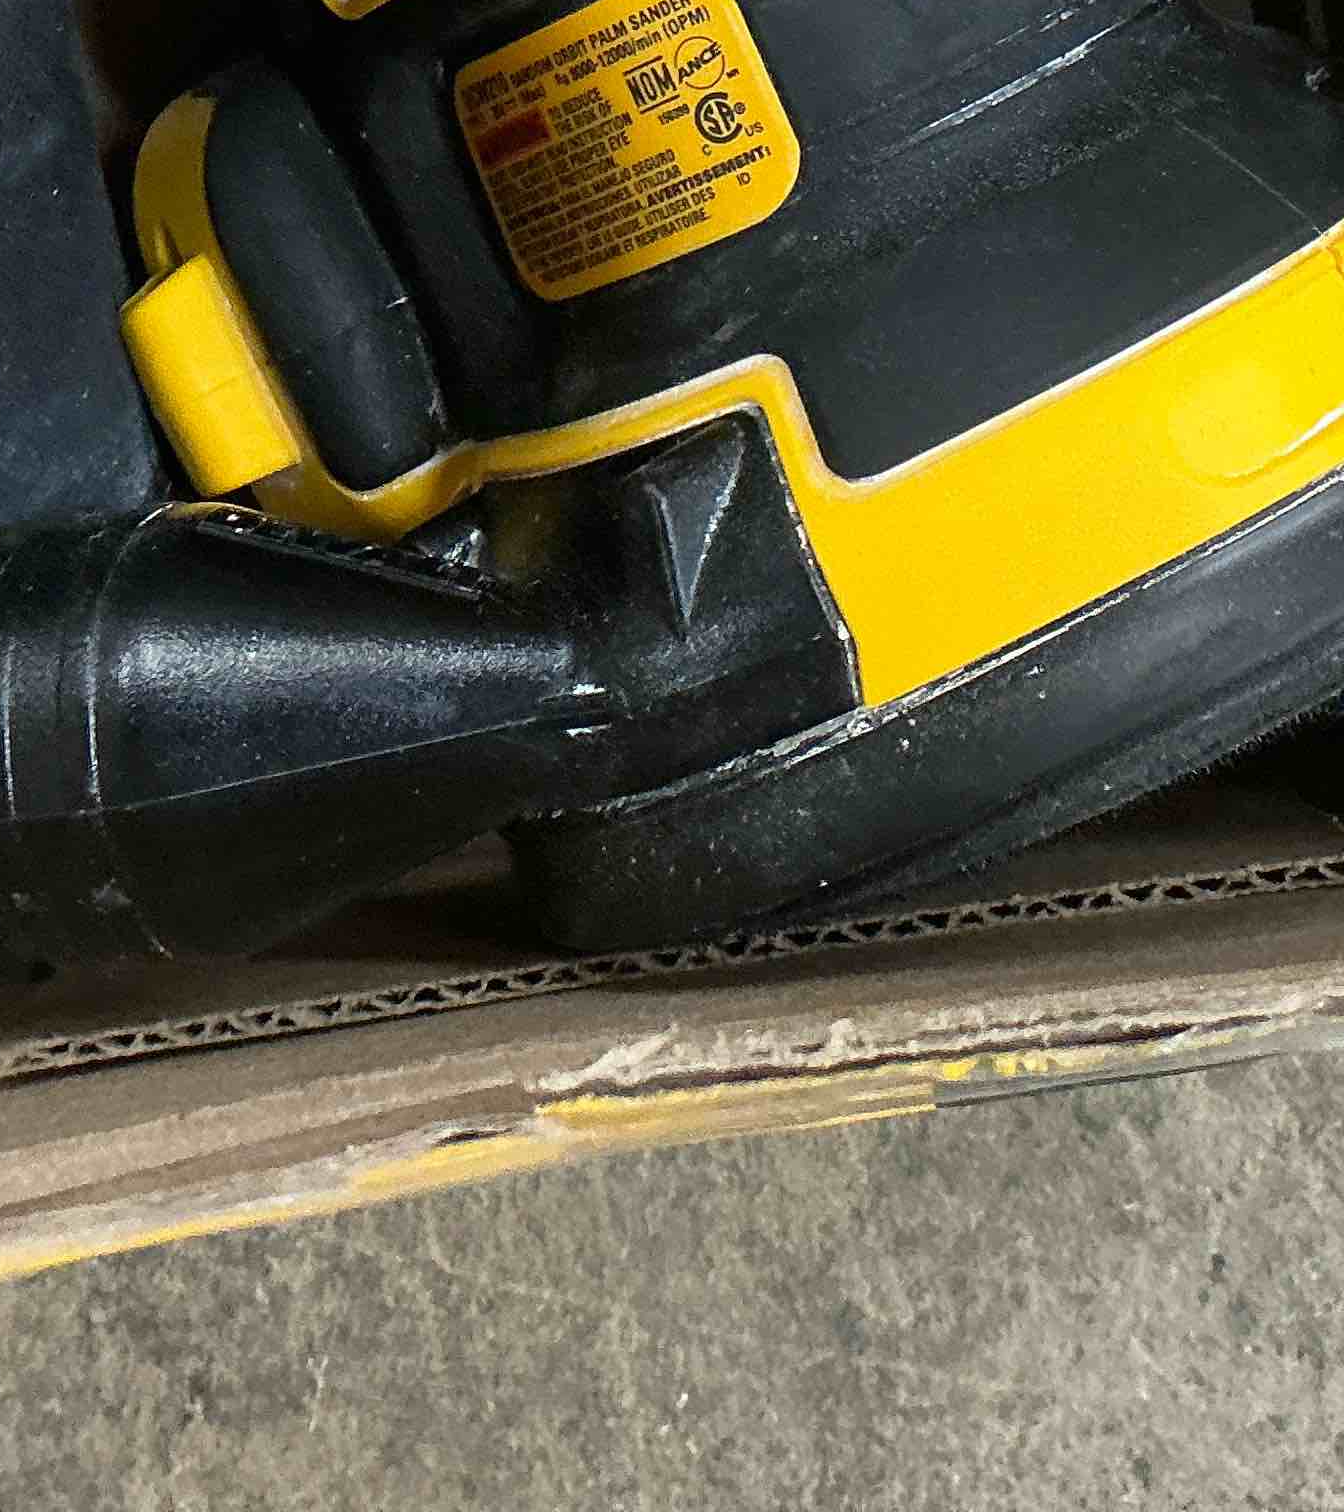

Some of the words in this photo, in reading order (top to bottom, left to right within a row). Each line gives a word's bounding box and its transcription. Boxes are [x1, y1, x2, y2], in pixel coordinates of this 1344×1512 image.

[588, 20, 628, 48] PALM
[661, 5, 710, 38] (OPM)
[673, 41, 725, 84] ANCE
[626, 62, 676, 107] NOM
[607, 129, 630, 151] EYE
[743, 121, 764, 137] US
[647, 145, 770, 206] AVERTISSEMENT:
[690, 185, 715, 206] DES
